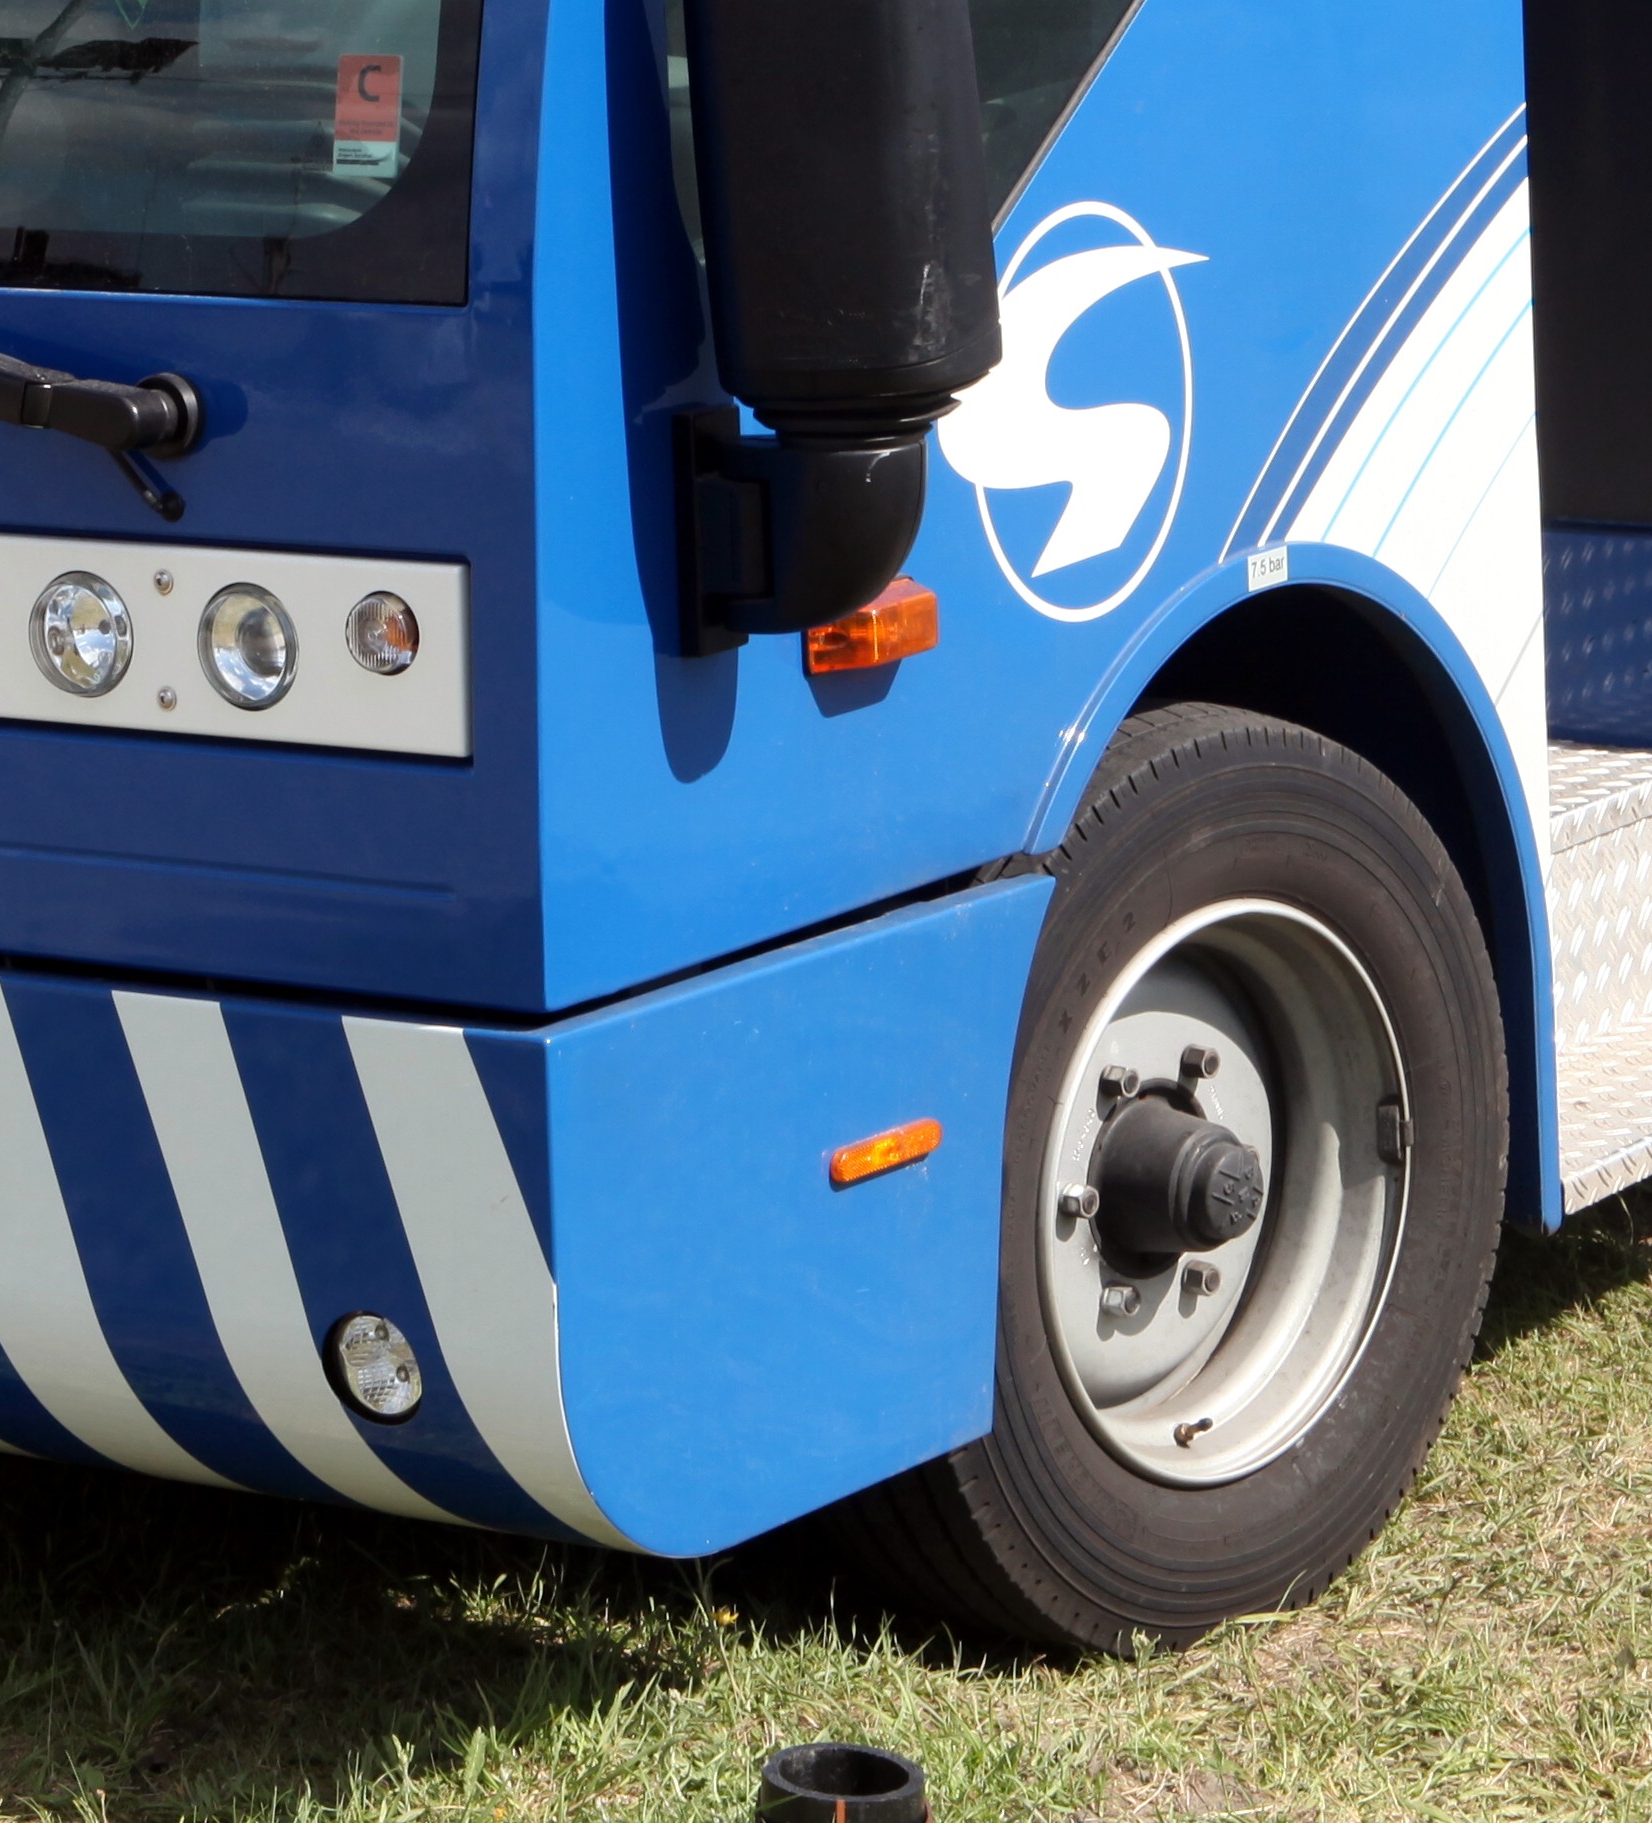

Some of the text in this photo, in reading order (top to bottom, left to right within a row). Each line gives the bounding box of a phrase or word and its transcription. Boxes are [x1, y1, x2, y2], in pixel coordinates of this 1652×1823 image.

[358, 64, 381, 102] C
[1251, 556, 1285, 579] 7.5 bar
